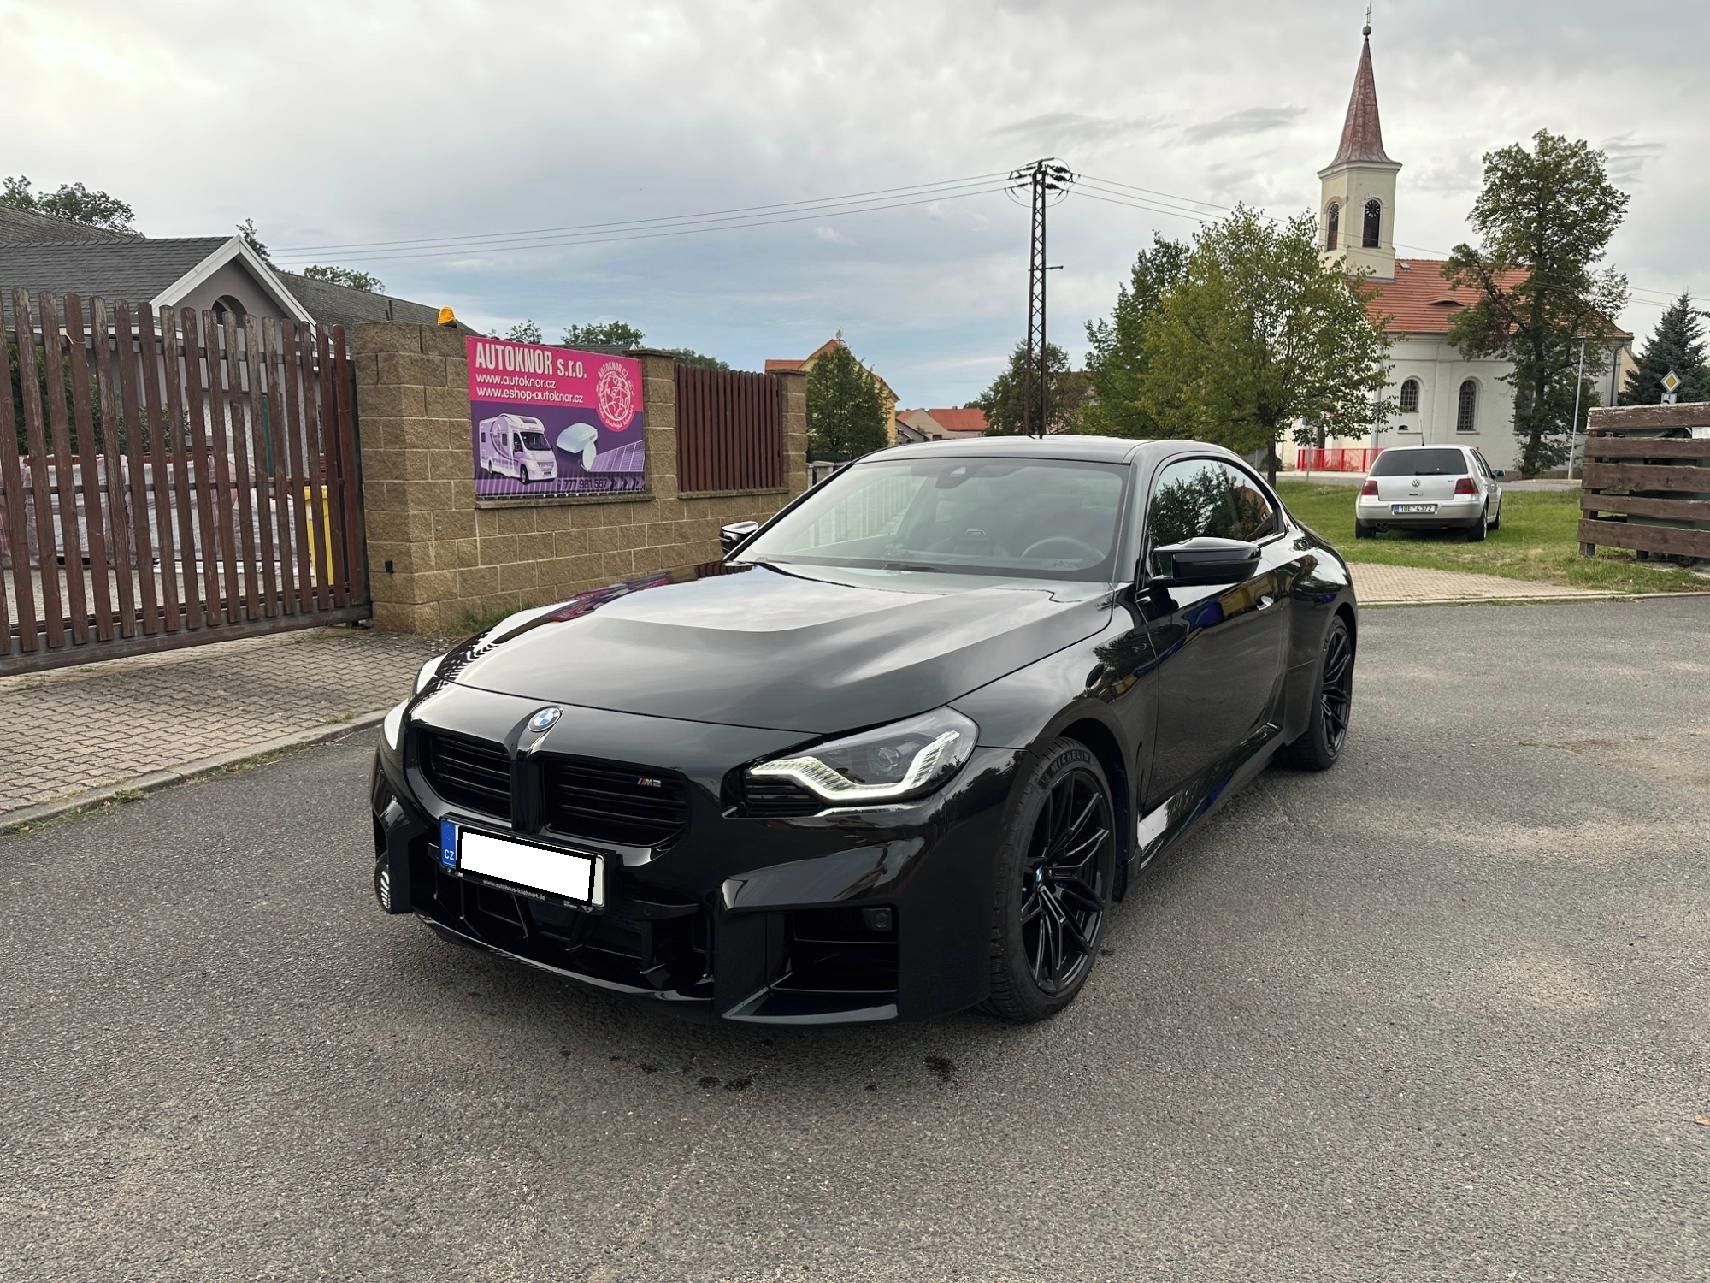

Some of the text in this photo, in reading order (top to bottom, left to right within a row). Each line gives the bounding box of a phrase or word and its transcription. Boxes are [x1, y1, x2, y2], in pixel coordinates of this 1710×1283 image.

[475, 342, 587, 379] AUTOKNOR s.r.o.
[476, 373, 556, 389] www.autoknor.cz
[476, 387, 584, 404] www.eshop-autoknor.cz
[444, 849, 455, 861] CZ
